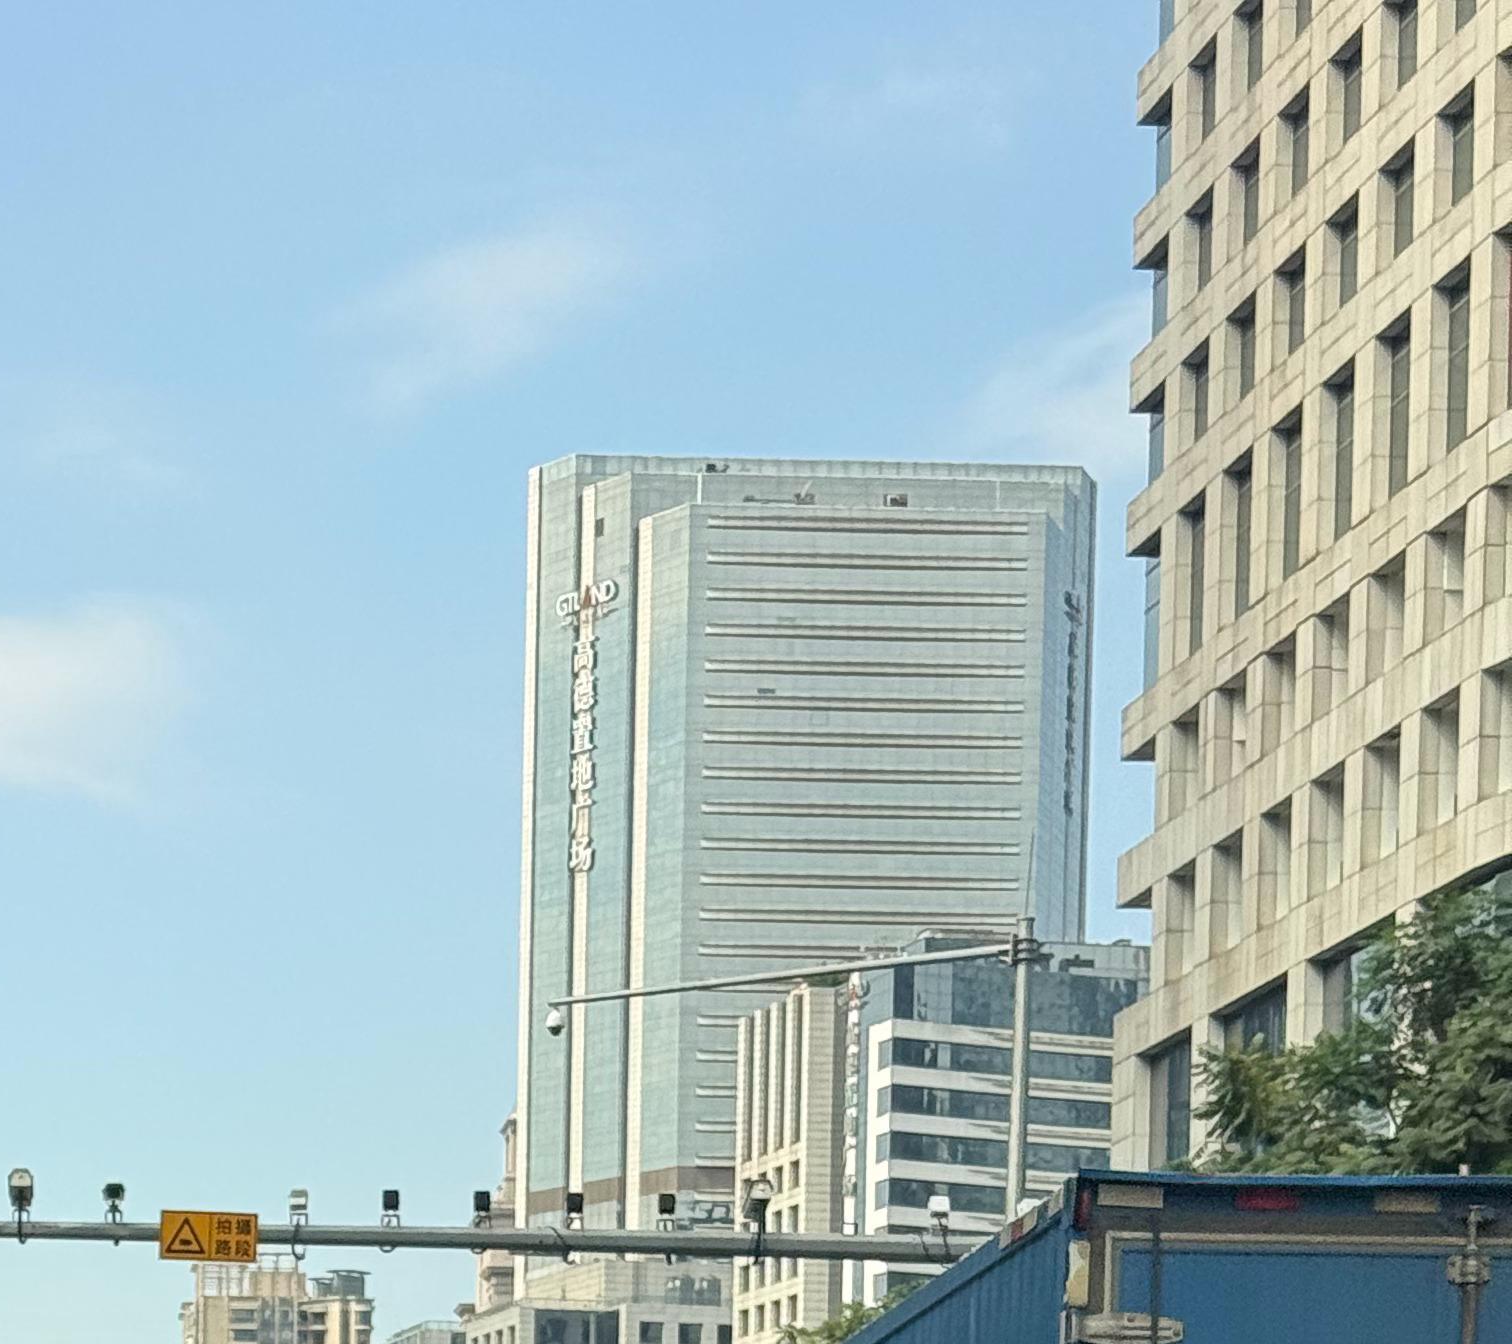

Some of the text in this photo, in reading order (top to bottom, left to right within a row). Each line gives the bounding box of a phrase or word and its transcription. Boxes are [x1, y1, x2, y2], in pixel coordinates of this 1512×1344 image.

[569, 637, 597, 871] 高德置地广场
[215, 1239, 251, 1257] 路段
